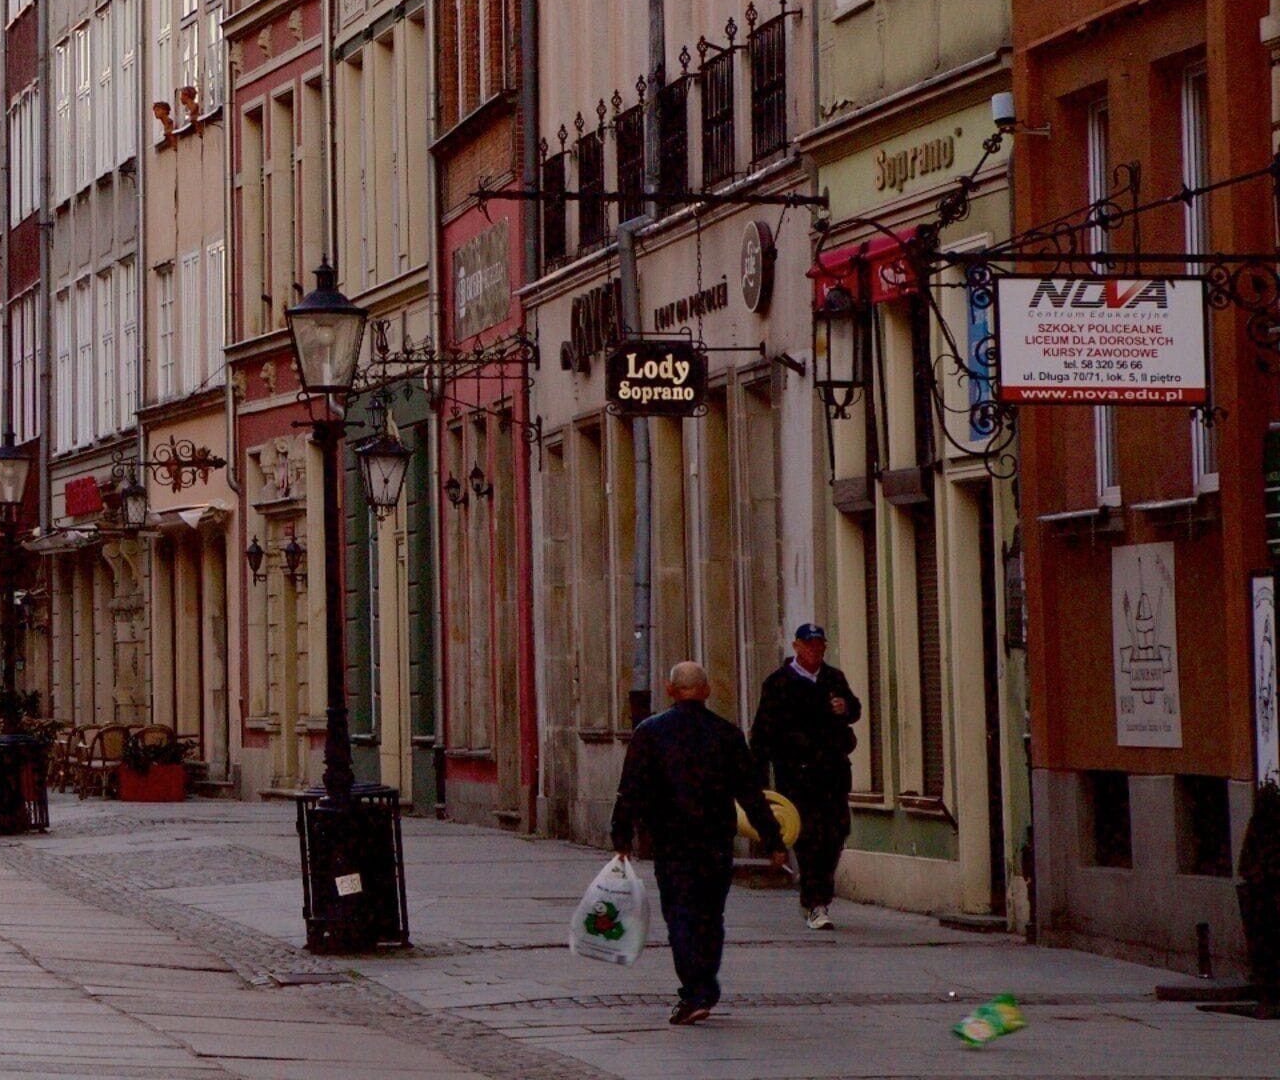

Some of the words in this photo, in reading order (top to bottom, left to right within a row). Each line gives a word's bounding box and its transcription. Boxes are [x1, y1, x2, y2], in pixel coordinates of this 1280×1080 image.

[875, 135, 954, 193] Soprano
[1029, 279, 1168, 308] NOVA
[1028, 310, 1085, 318] Centrum
[1090, 310, 1169, 319] Edukacyjne
[1038, 324, 1084, 333] SZKOŁY
[1088, 324, 1162, 334] POLICEALNE
[1025, 336, 1069, 345] LICEUM
[1072, 336, 1096, 345] DLA
[1099, 336, 1174, 346] DOROSŁYCH
[1043, 348, 1083, 357] KURSY
[1086, 348, 1158, 358] ZAWODOWE
[626, 352, 690, 385] Lody
[1064, 360, 1077, 369] tel.
[1081, 360, 1092, 369] 58
[1096, 360, 1113, 369] 320
[1116, 361, 1128, 369] 56
[1130, 361, 1143, 369] 66
[1023, 372, 1035, 381] ul.
[1039, 372, 1070, 383] Długa
[1073, 373, 1104, 382] 70/71,
[1106, 372, 1125, 381] lok.
[1128, 373, 1138, 383] 5,
[1150, 373, 1181, 384] piętro
[618, 380, 695, 404] Soprano
[1021, 389, 1183, 401] www.nova.edu.pl
